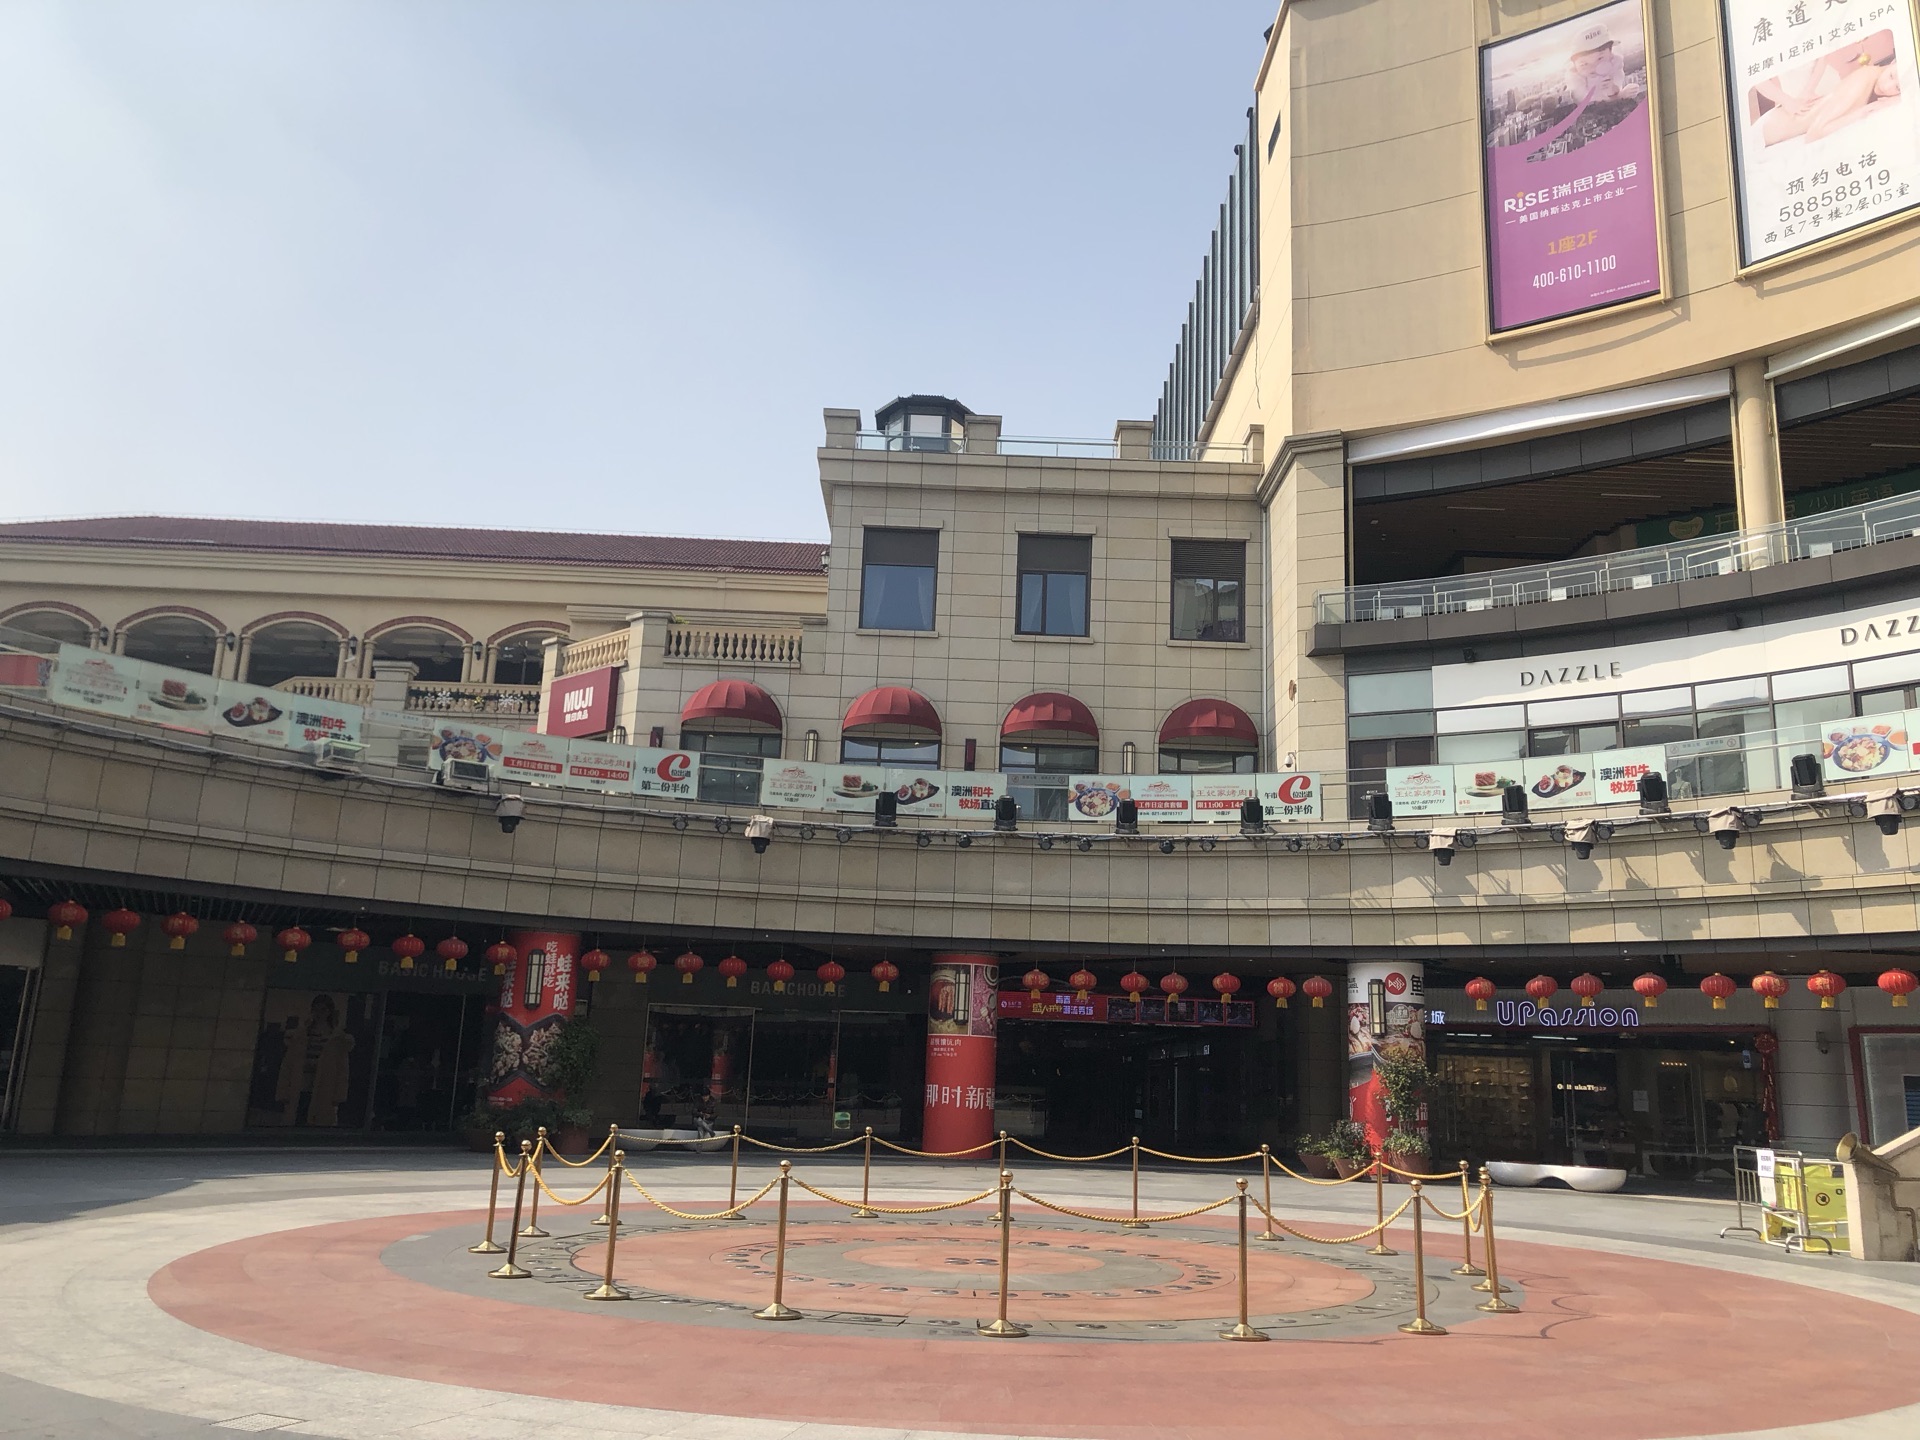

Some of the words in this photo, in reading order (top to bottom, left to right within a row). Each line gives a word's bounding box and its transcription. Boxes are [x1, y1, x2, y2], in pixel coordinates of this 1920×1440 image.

[1752, 0, 1848, 45] 康道
[1748, 56, 1775, 77] 按摩
[1788, 39, 1815, 60] 足浴
[1829, 22, 1858, 42] 艾灸
[1869, 4, 1896, 22] SPA
[1552, 162, 1638, 200] 瑞思英语
[1785, 150, 1878, 196] 预约电话
[1779, 168, 1891, 223] 58858819
[1764, 182, 1910, 244] 西区7号楼2层05室
[1548, 229, 1598, 256] 1座2F
[1532, 254, 1617, 289] 400-610-1100
[1520, 661, 1622, 687] DAZZLE
[563, 686, 594, 713] MUJI
[296, 711, 346, 732] 澳洲和牛
[607, 771, 628, 780] 14:00
[1599, 763, 1651, 781] 澳洲和牛
[641, 780, 690, 794] 第二份半价
[951, 785, 994, 798] 澳洲和牛
[1609, 779, 1641, 795] 牧场
[1139, 801, 1183, 809] 工作日定食套餐
[1264, 805, 1313, 815] 第二份半价
[543, 941, 559, 988] 吃蛙就吃
[553, 954, 573, 1011] 蛙来哒
[1496, 1001, 1639, 1027] UPassion
